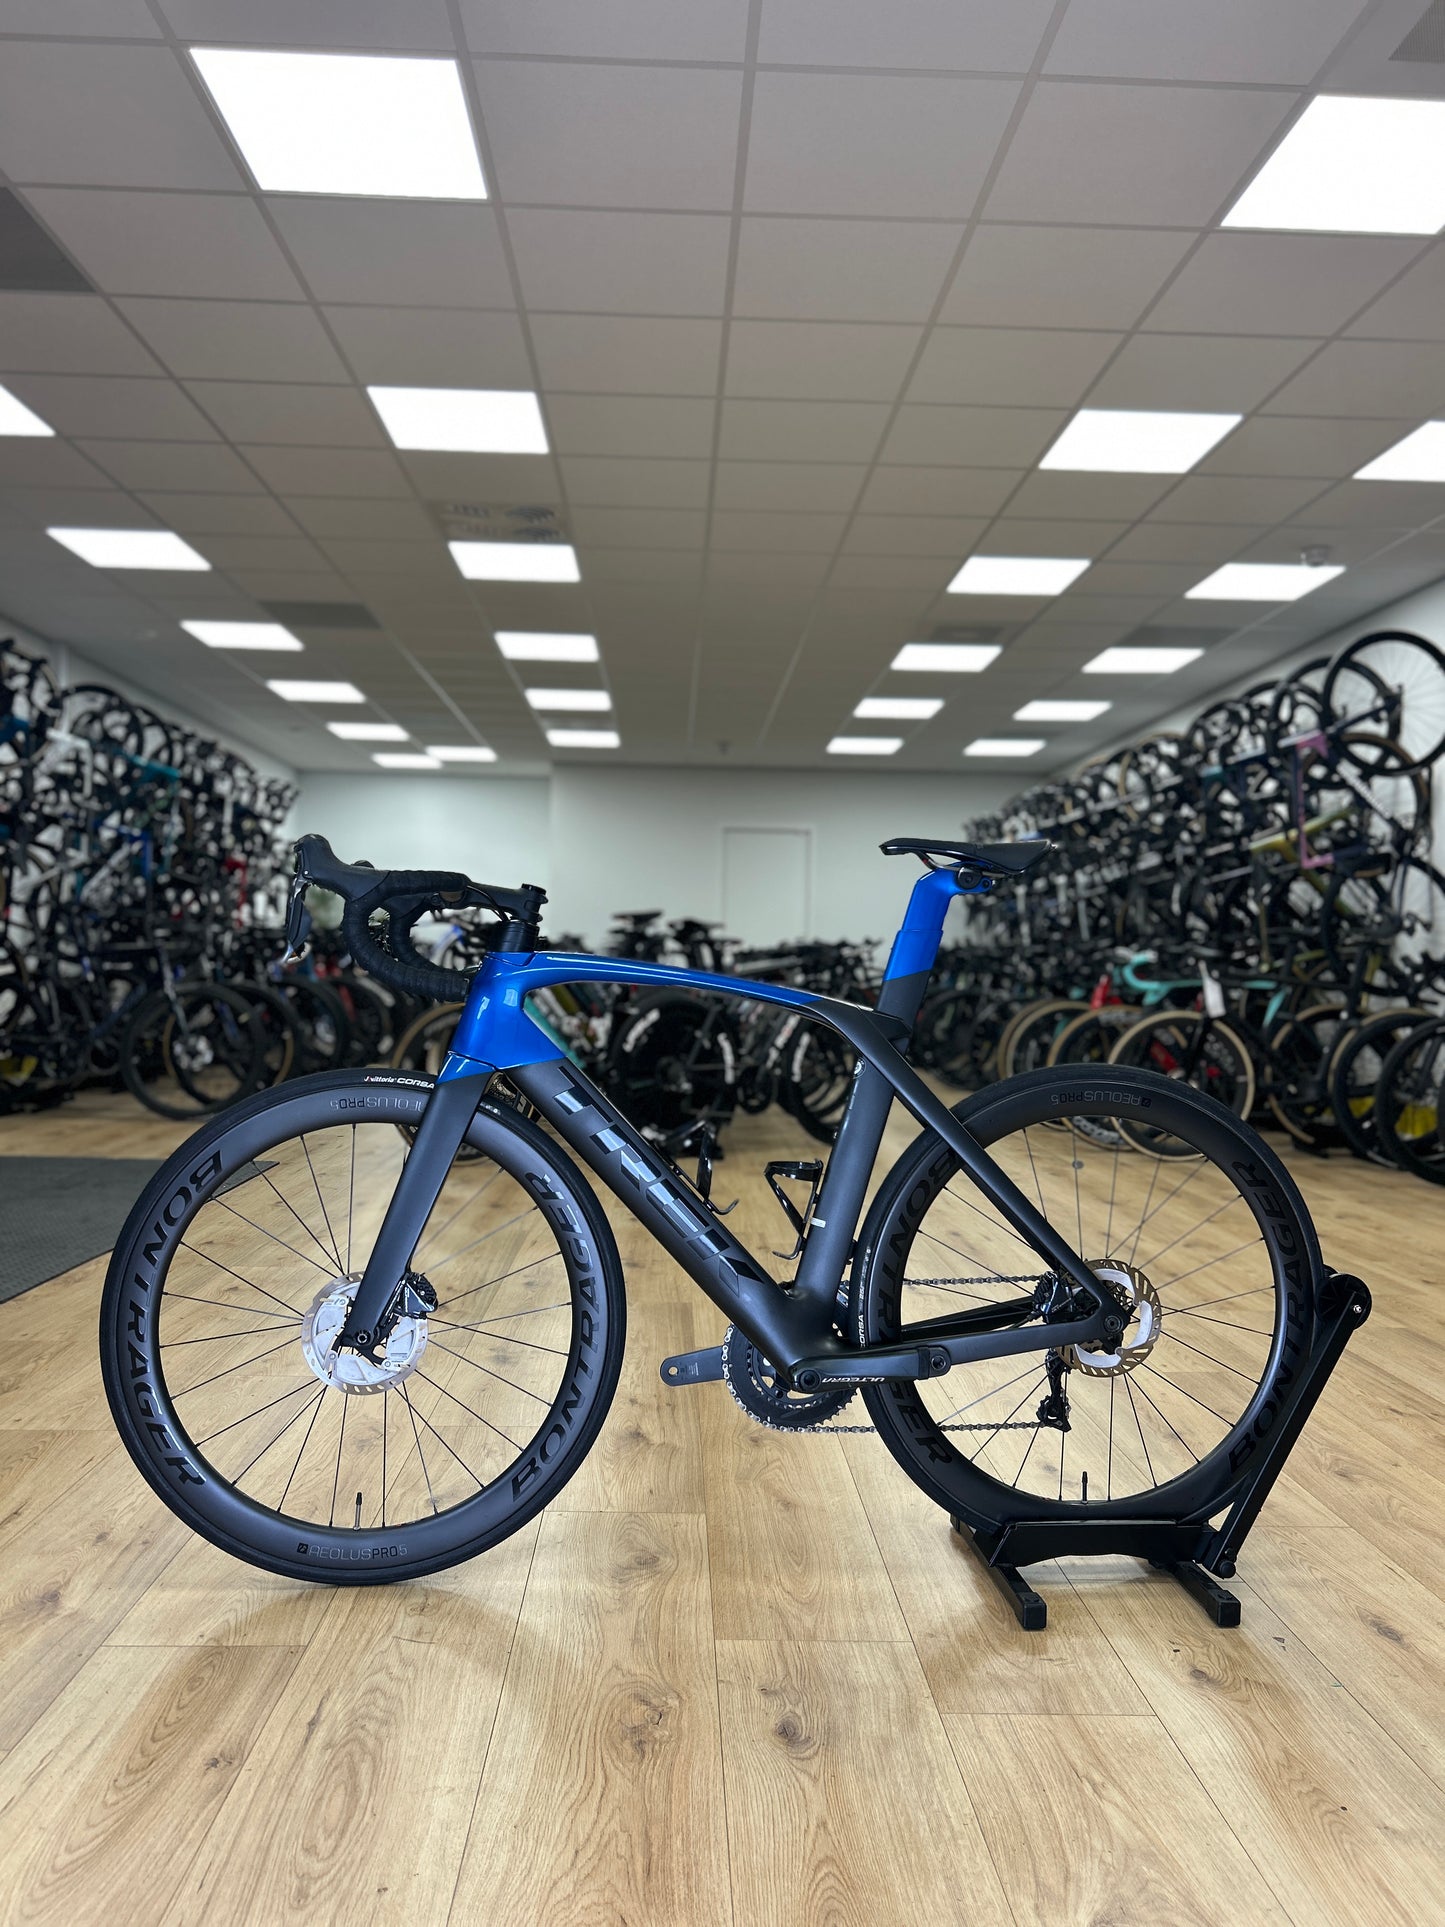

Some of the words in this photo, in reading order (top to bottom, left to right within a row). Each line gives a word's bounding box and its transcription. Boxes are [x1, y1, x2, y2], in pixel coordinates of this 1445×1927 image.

[397, 1078, 435, 1089] CORSA
[554, 1066, 765, 1298] TREK
[128, 1150, 222, 1485] BONTRAGER
[511, 1172, 600, 1501] BONTRAGER
[821, 1376, 886, 1384] ULTEGRA
[1228, 1161, 1304, 1474] BONTRAGER
